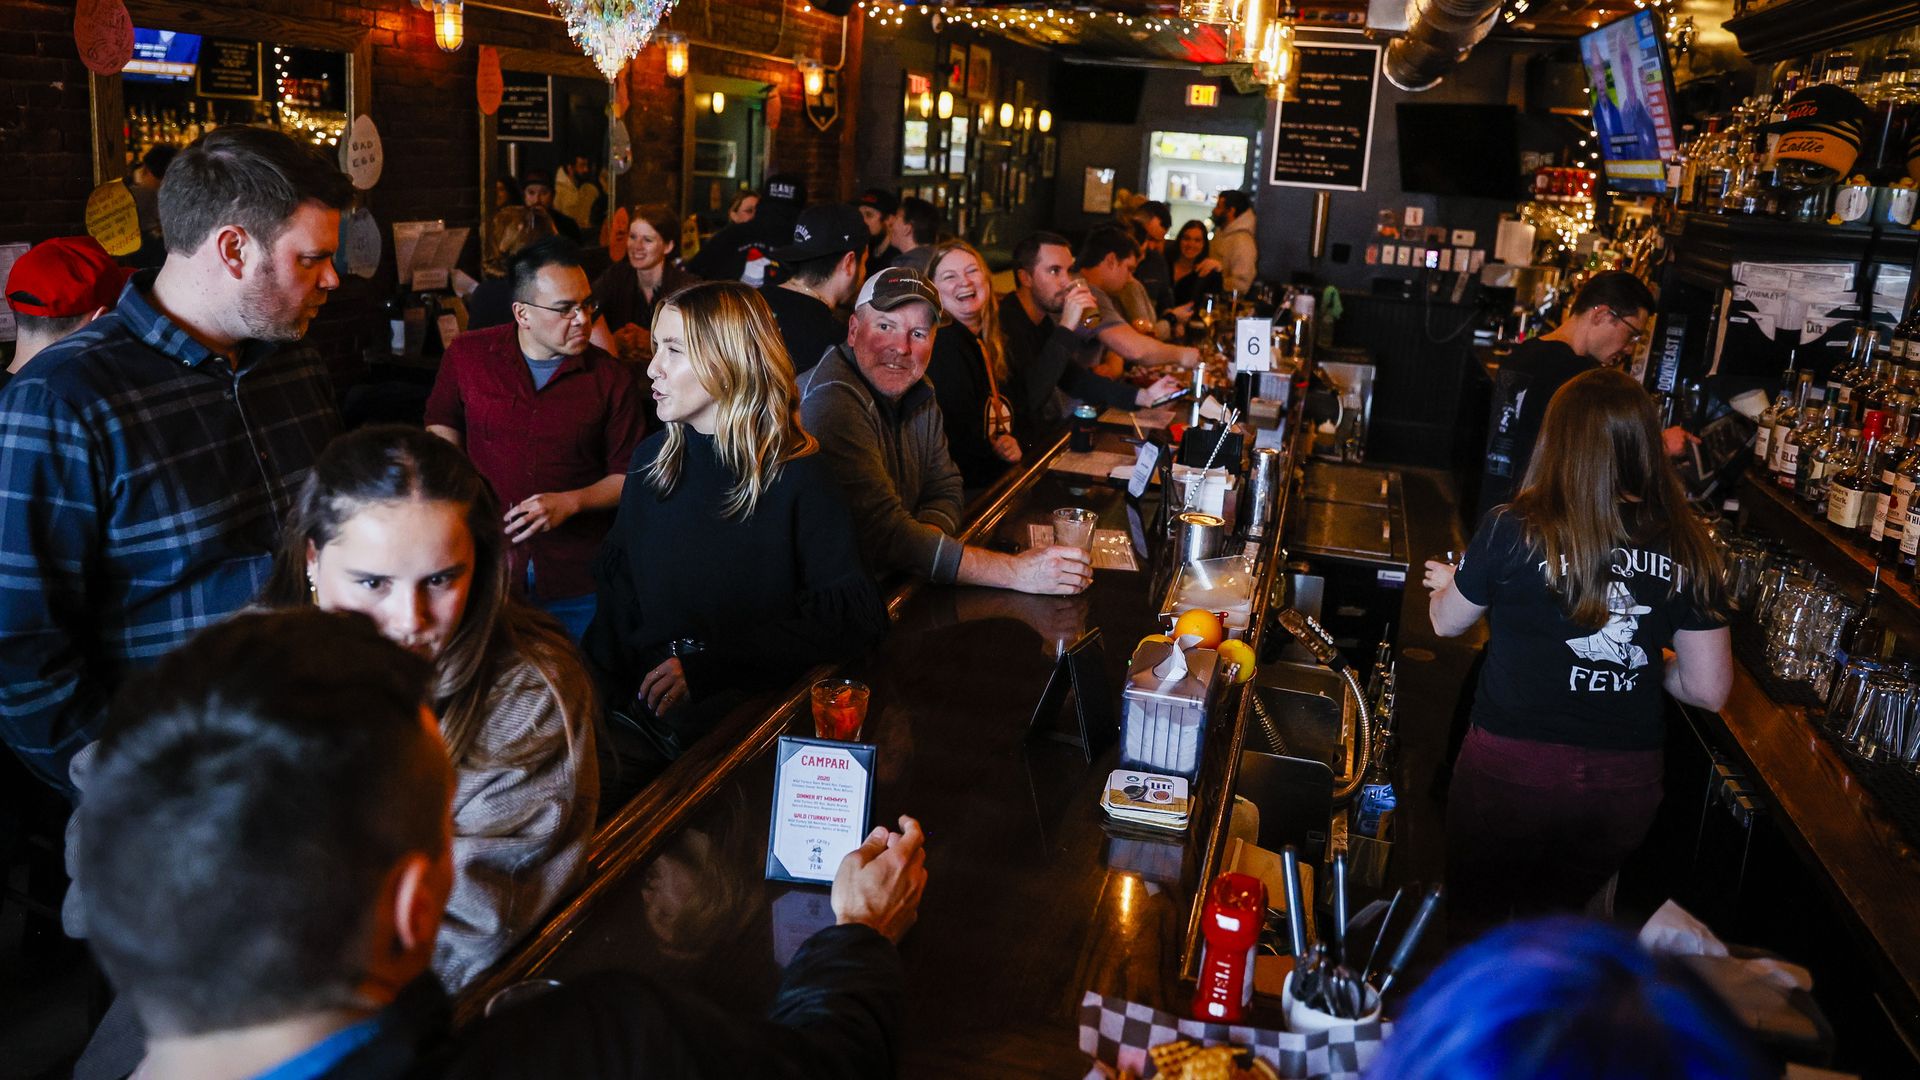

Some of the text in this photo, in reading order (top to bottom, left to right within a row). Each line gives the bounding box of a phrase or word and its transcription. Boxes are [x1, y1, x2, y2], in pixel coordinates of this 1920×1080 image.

[352, 141, 374, 151] BAD
[1778, 140, 1825, 153] Eastie
[352, 156, 376, 168] EGG
[1247, 336, 1260, 356] 6
[1657, 338, 1680, 391] DOWNEAST
[1611, 547, 1689, 594] QUIET
[1569, 665, 1640, 692] FEW
[801, 755, 849, 770] CAMPARI
